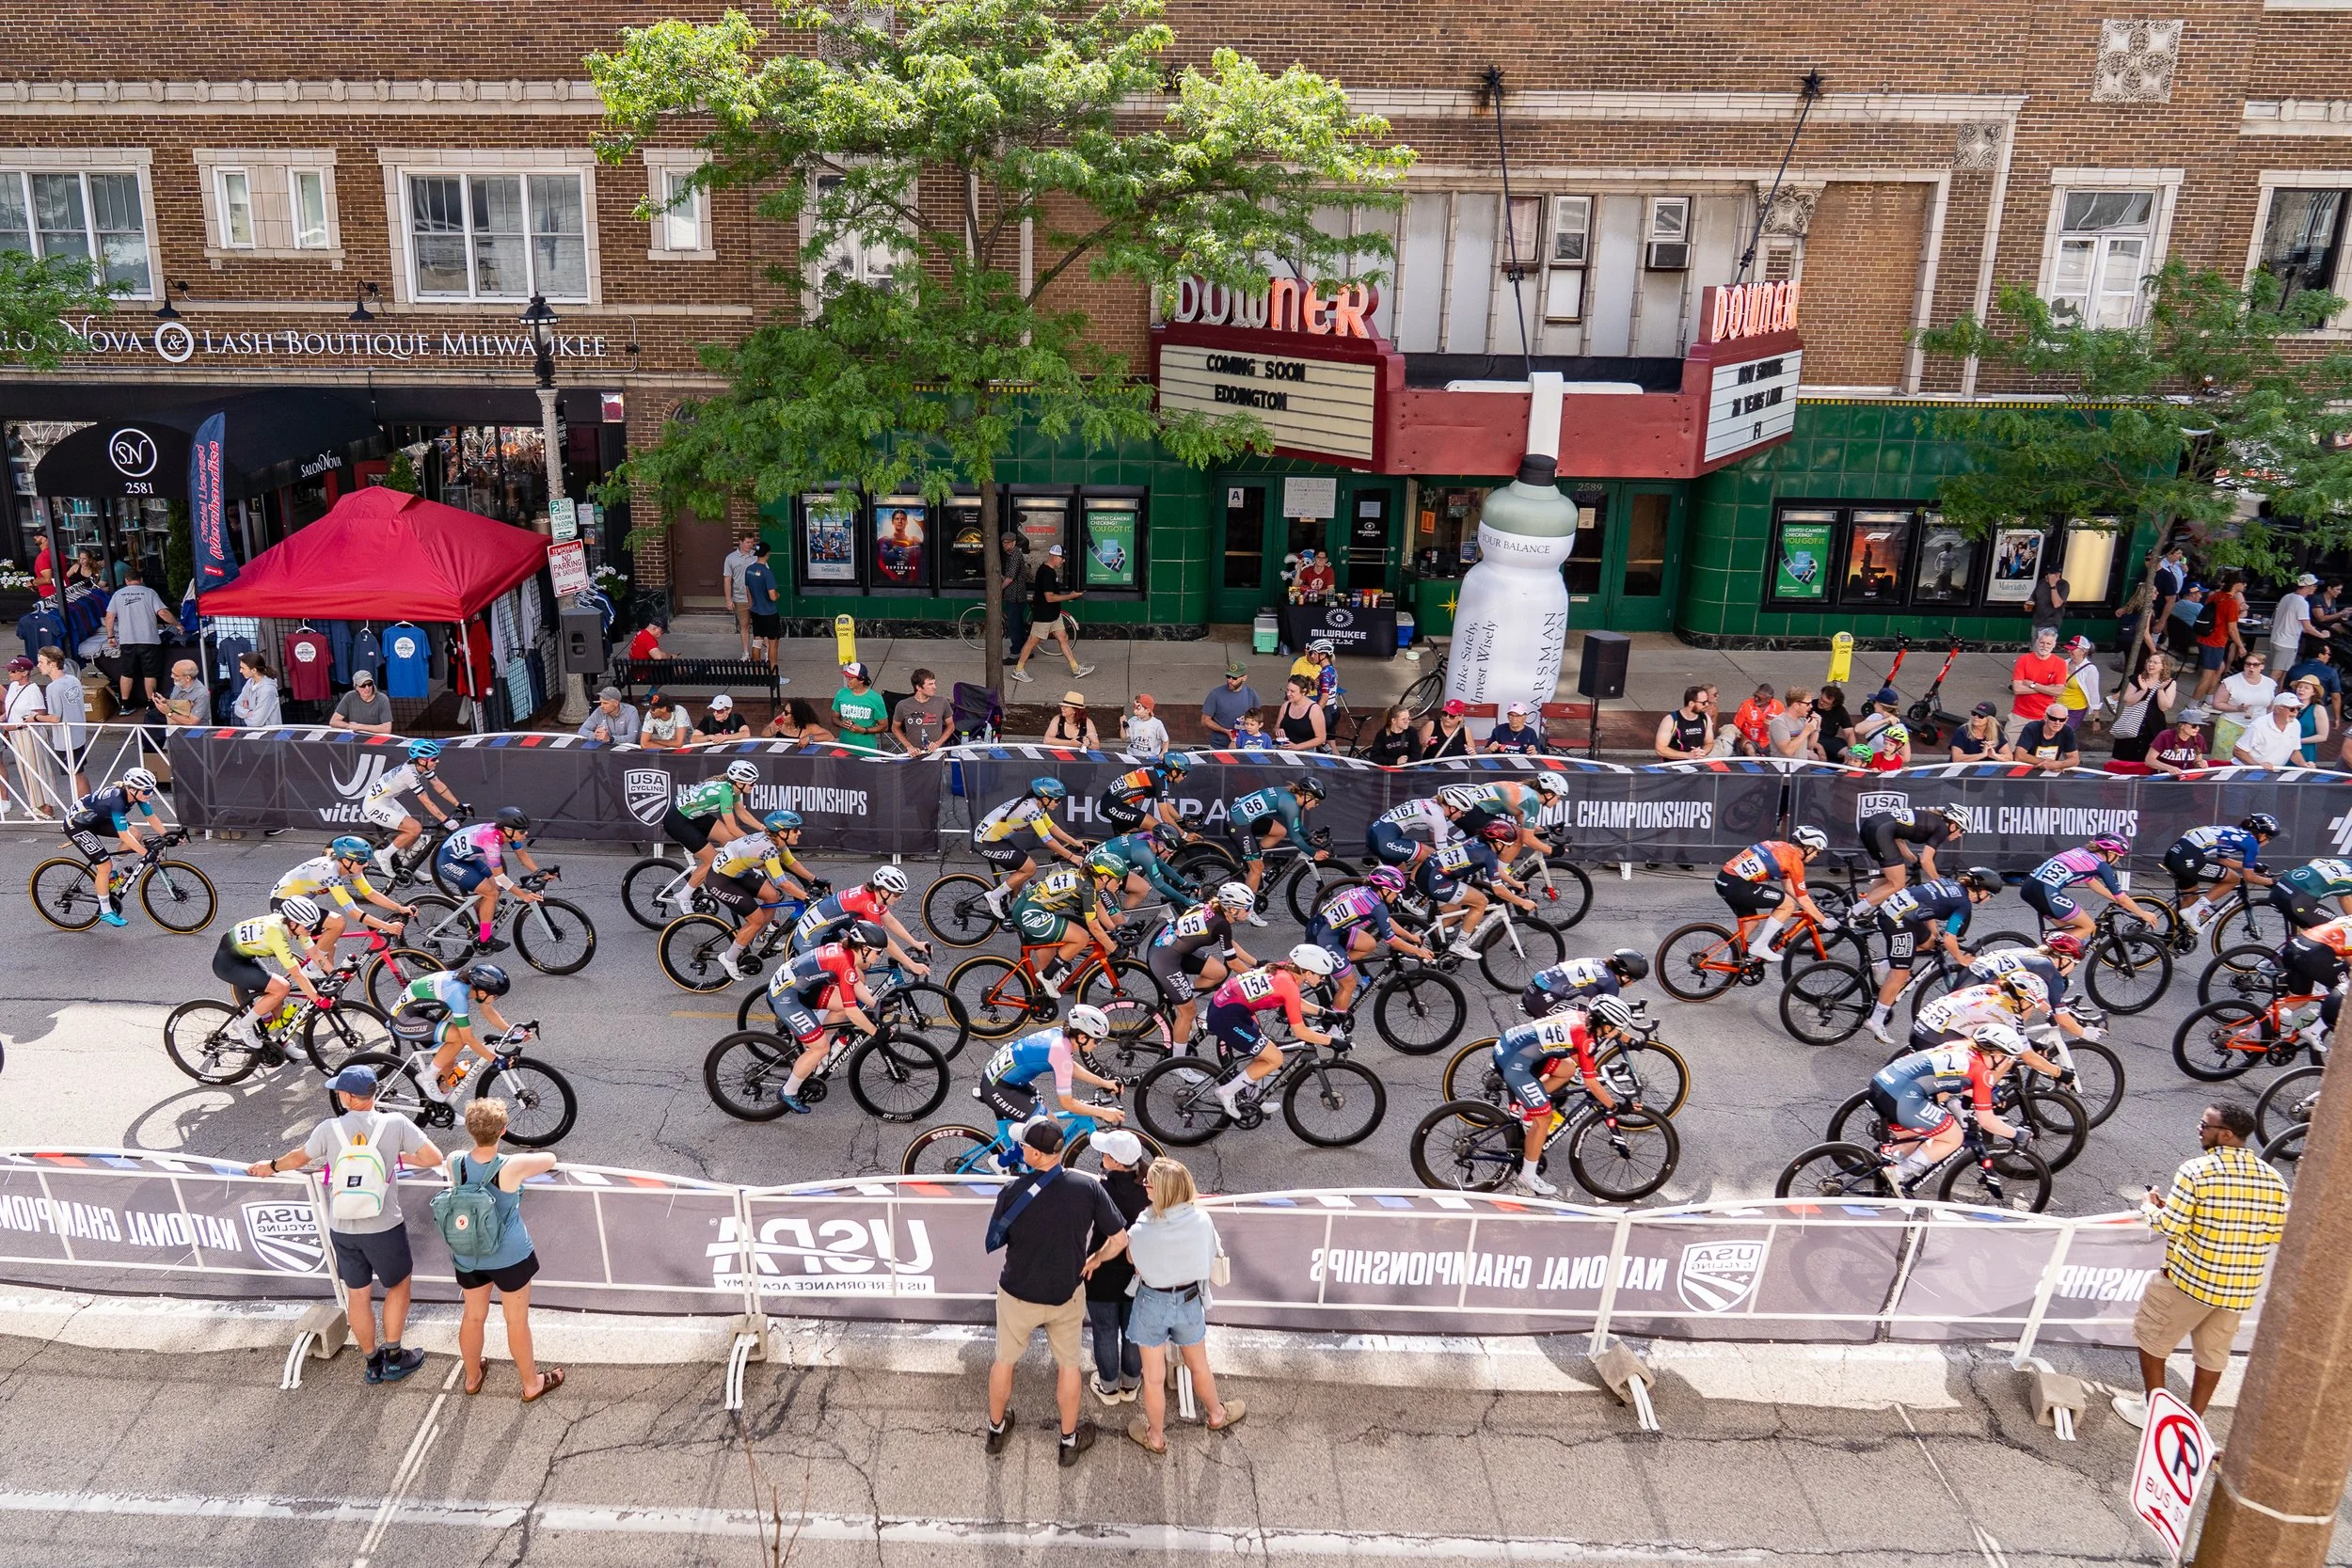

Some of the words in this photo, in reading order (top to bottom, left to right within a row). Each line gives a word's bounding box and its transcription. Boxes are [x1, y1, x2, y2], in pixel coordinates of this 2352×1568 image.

[204, 330, 274, 355] LASH
[287, 330, 430, 360] BOUTIQUE
[1206, 354, 1256, 376] COMING
[1264, 360, 1306, 381] SOON
[1215, 385, 1288, 411] EDDINGTON
[196, 444, 207, 499] Licensed
[125, 482, 154, 495] 2581
[1232, 491, 1241, 500] A
[1578, 483, 1603, 492] 2589
[208, 441, 225, 560] Merchandise
[551, 504, 561, 515] 2
[1482, 533, 1502, 548] YOUR
[1503, 540, 1550, 555] BALANCE
[553, 559, 582, 572] PARKING
[562, 553, 571, 562] NO
[562, 566, 583, 577] SATURDAY
[1311, 628, 1367, 640] MILWAUKEE
[1461, 622, 1479, 662] Safely,
[1476, 620, 1499, 663] Wisely
[1455, 664, 1469, 692] Bike
[1470, 667, 1487, 704] Invest
[371, 782, 384, 797] 35
[631, 774, 664, 785] USA
[751, 784, 867, 816] CHAMPIONSHIPS
[1476, 787, 1491, 800] 31
[1865, 797, 1899, 808] USA
[1245, 798, 1263, 815] 86
[1578, 800, 1712, 830] CHAMPIONSHIPS
[976, 822, 989, 838] 44
[1998, 806, 2138, 837] CHAMPIONSHIPS
[715, 852, 730, 868] 33
[1447, 849, 1461, 865] 37
[1741, 859, 1759, 876] 45
[2041, 863, 2068, 884] 133
[1053, 875, 1069, 890] 47
[708, 886, 743, 906] SWEAT
[1890, 896, 1908, 912] 14
[802, 913, 818, 930] 11
[1330, 903, 1349, 923] 30
[240, 925, 254, 942] 51
[1183, 915, 1200, 935] 55
[1894, 934, 1906, 956] 28
[1578, 966, 1587, 979] 4
[1993, 956, 2017, 974] 29
[773, 969, 790, 988] 42
[1173, 970, 1194, 998] PARKS
[1242, 974, 1269, 998] 154
[281, 1000, 314, 1043] LOOK
[788, 1009, 817, 1034] UTC
[1930, 1005, 1953, 1025] 39
[1545, 1024, 1565, 1043] 46
[828, 1035, 865, 1074] SPECIALIZED
[986, 1051, 1013, 1078] 172
[1944, 1053, 1957, 1071] 2
[453, 1062, 485, 1097] AURUM
[1521, 1081, 1549, 1107] UTC
[992, 1091, 1026, 1119] KENETIK
[1919, 1101, 1947, 1124] UTC
[882, 1112, 894, 1120] DT
[894, 1113, 913, 1121] SWISS
[1542, 1123, 1571, 1151] QUICK
[1569, 1105, 1590, 1127] PRO
[1912, 1163, 1944, 1193] QUICK
[2145, 1477, 2171, 1510] BUS
